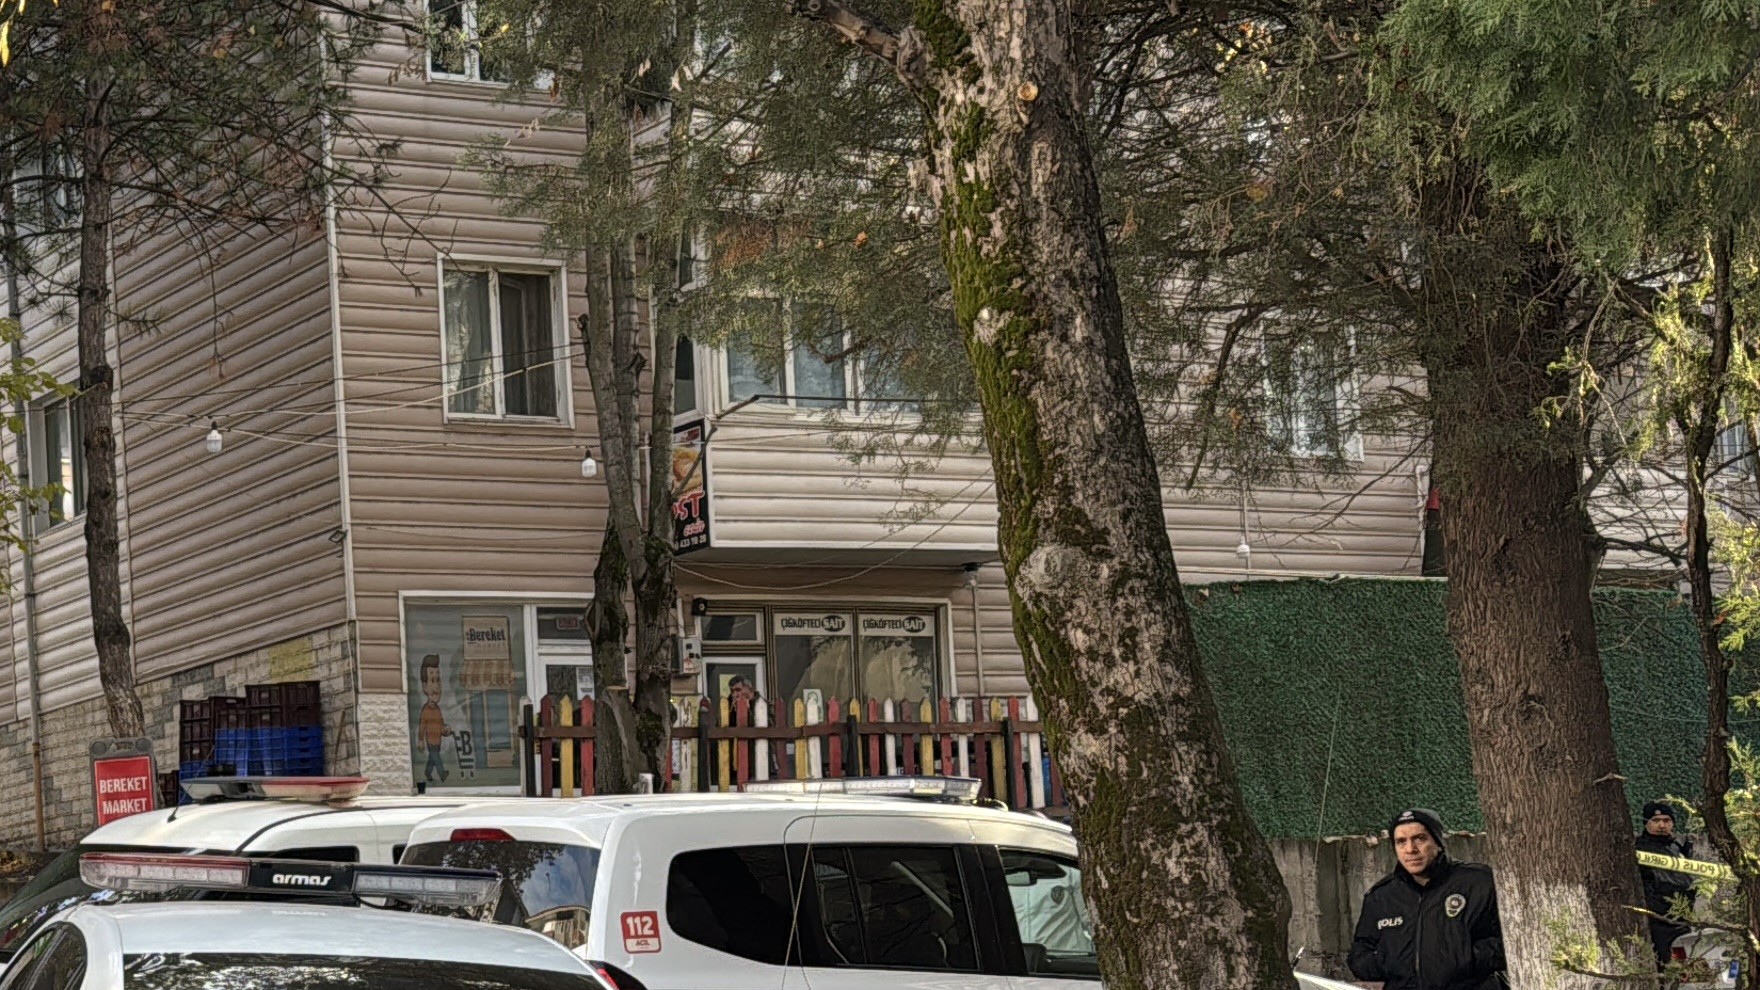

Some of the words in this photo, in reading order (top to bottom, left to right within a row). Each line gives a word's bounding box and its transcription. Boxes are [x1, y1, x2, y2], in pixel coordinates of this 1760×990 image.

[469, 626, 506, 642] Bereket
[99, 776, 148, 794] BEREKET
[102, 798, 148, 815] MARKET
[272, 873, 332, 886] armas
[626, 915, 655, 937] 112
